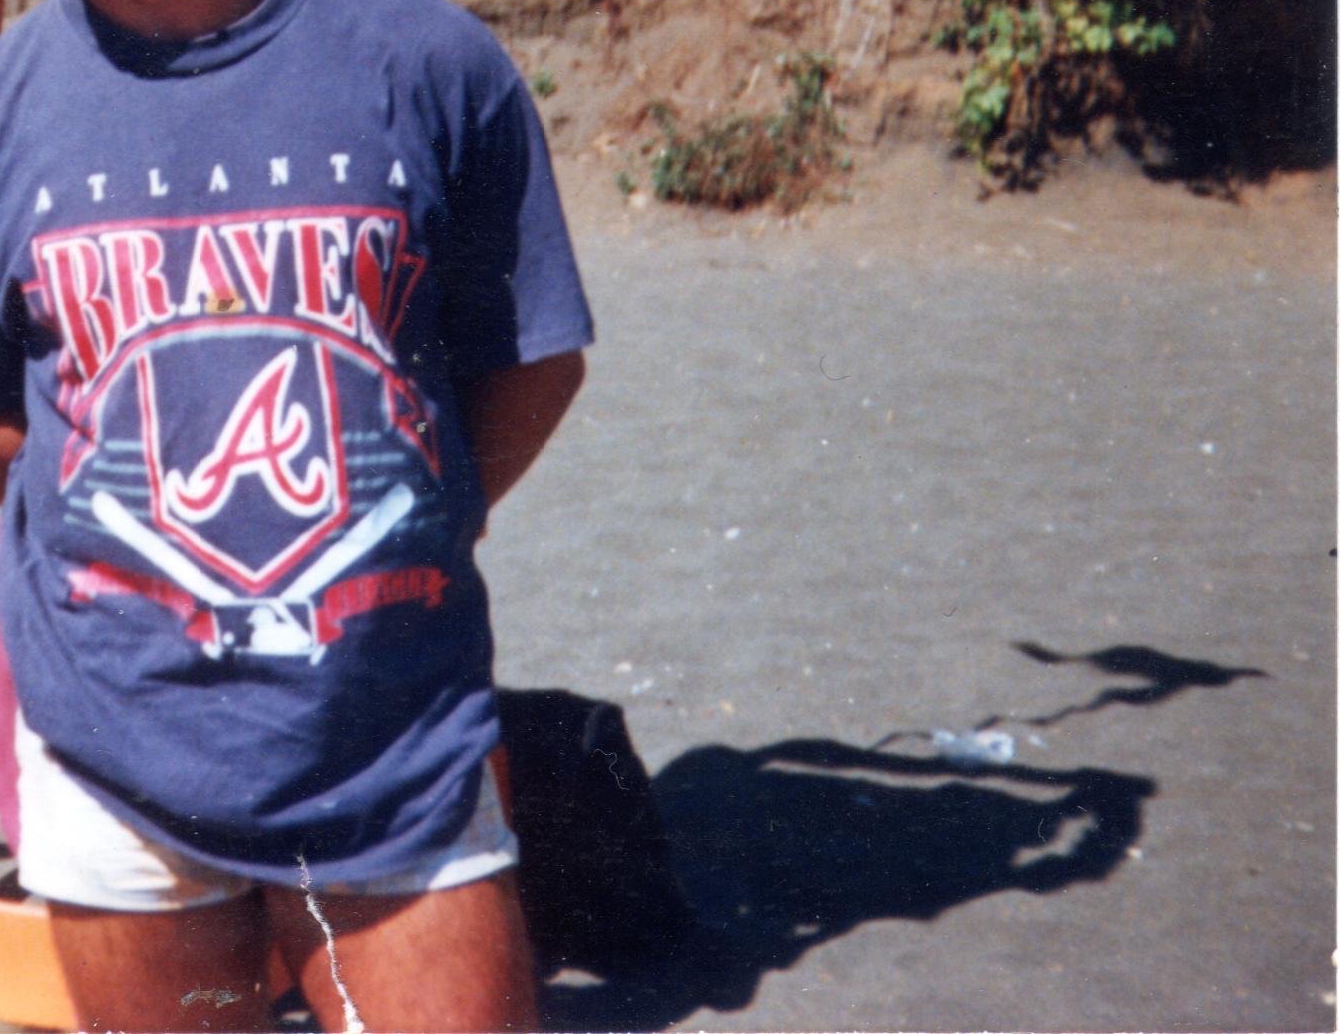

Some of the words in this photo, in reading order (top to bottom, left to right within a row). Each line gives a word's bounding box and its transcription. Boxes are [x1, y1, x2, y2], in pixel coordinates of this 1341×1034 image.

[34, 153, 407, 214] ATLANTA
[43, 215, 398, 395] BRAVES
[164, 345, 333, 523] A
